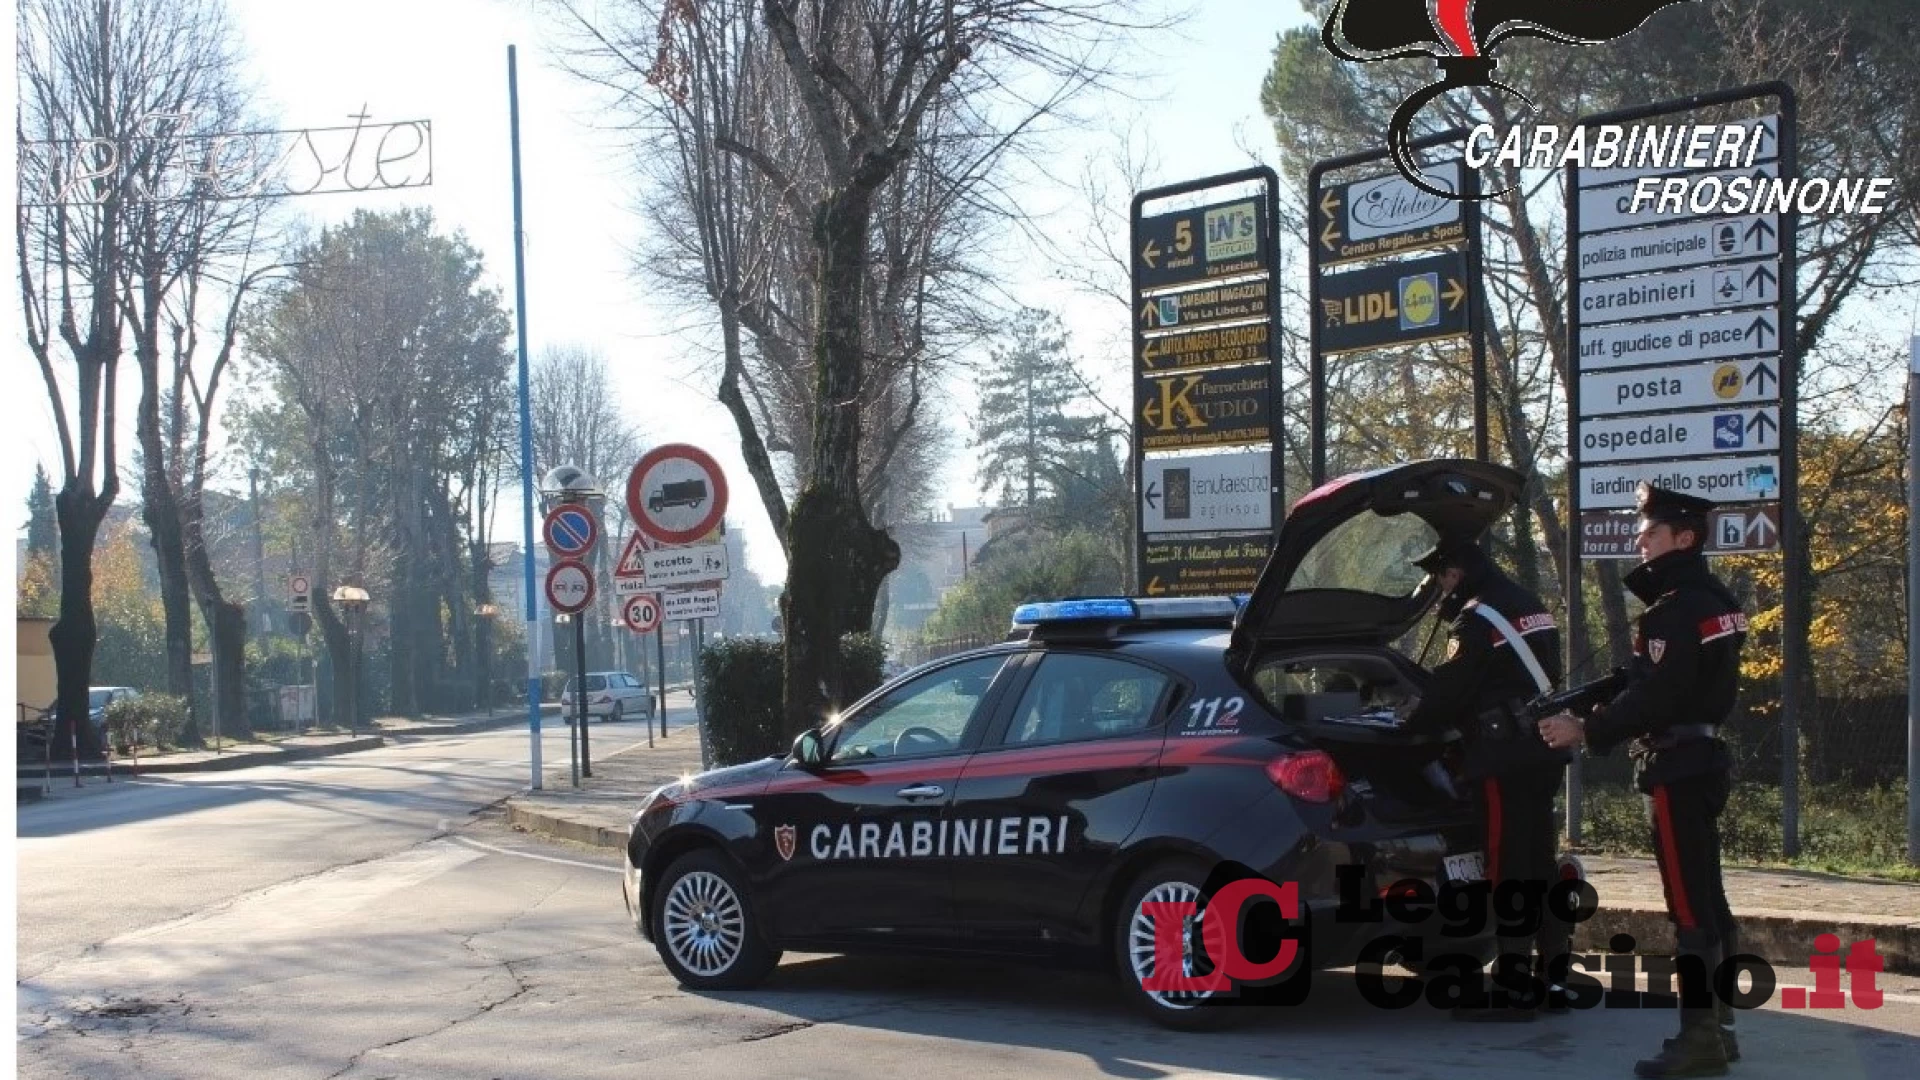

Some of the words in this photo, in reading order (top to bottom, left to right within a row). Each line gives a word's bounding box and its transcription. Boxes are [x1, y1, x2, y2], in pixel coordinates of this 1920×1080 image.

[1341, 241, 1376, 257] Centro
[1433, 223, 1463, 240] Sposi
[1582, 246, 1626, 269] polizia
[1631, 235, 1706, 256] municipale
[1344, 291, 1398, 325] LIDL
[1583, 279, 1695, 311] carabinieri
[1581, 338, 1606, 357] uff.
[1612, 333, 1673, 358] giudice
[1678, 330, 1693, 347] di
[1699, 327, 1742, 348] pace
[1157, 375, 1208, 429] K
[1617, 376, 1682, 404] posta
[1584, 423, 1688, 451] ospedale
[1652, 473, 1692, 490] dello
[1583, 539, 1619, 553] torre
[653, 556, 693, 569] eccetto
[632, 605, 653, 623] 30
[1187, 696, 1245, 728] 112
[810, 815, 1069, 860] CARABINIERI
